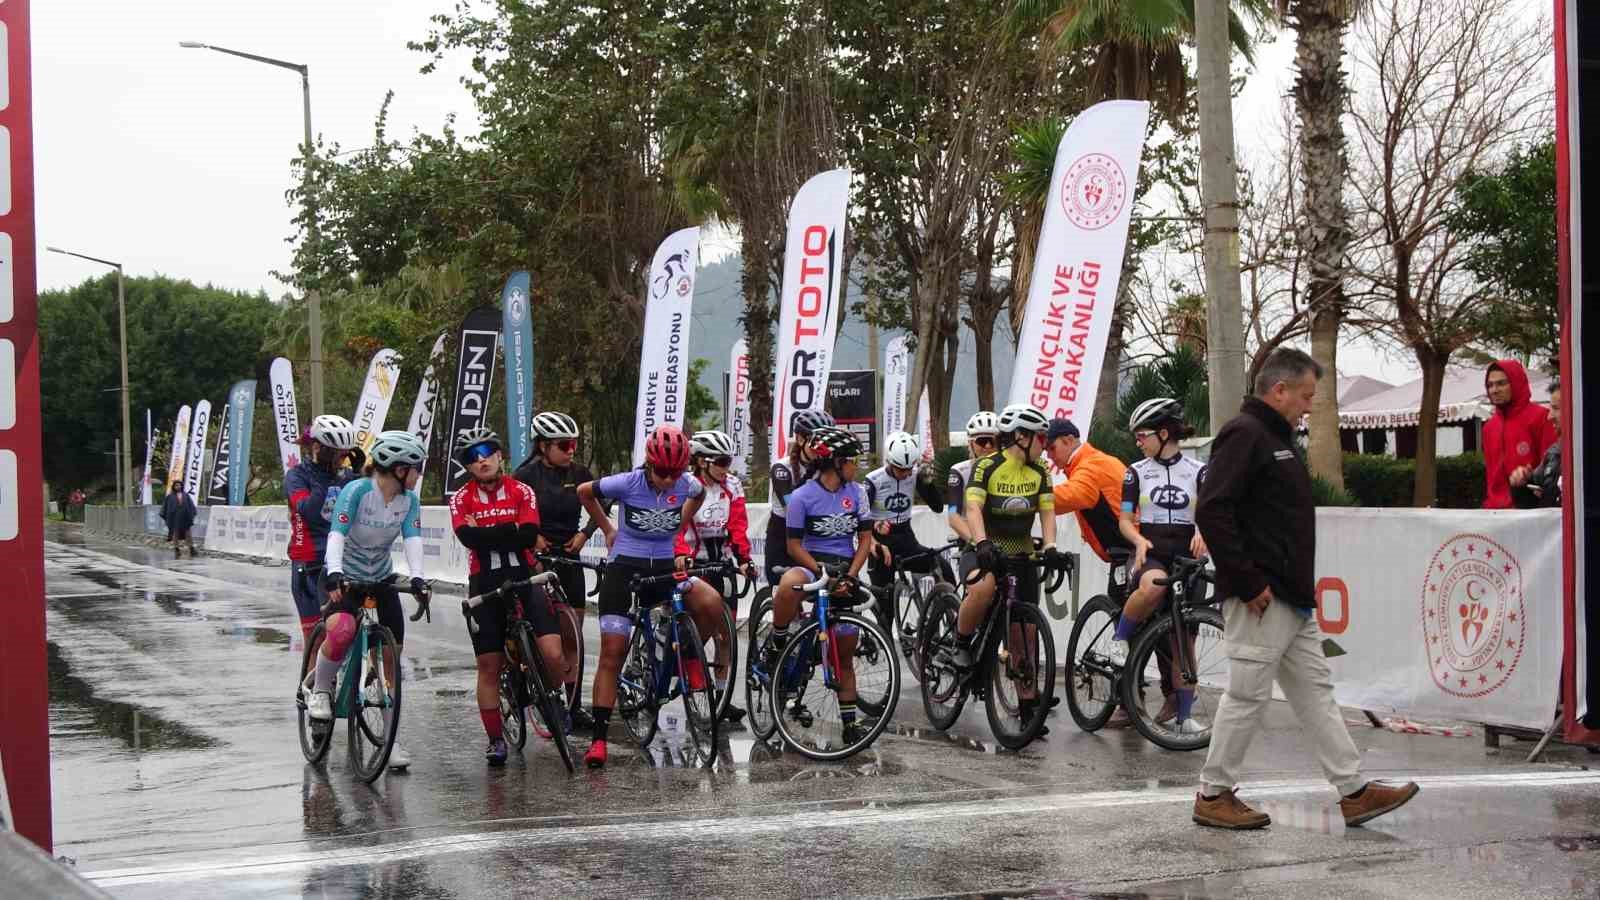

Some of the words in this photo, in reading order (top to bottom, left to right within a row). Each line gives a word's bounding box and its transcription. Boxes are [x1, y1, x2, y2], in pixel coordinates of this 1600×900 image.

[794, 225, 827, 345] TOTO
[1059, 261, 1101, 402] BAKANLIĞI
[664, 312, 683, 422] FEDERASYONU
[1031, 303, 1067, 410] GENÇLİK
[1052, 264, 1074, 297] VE
[275, 384, 290, 443] ANJELIQ
[450, 346, 487, 479] VDEN
[788, 350, 817, 438] OR
[830, 388, 861, 397] IŞLARI
[188, 412, 207, 495] MERCADO
[213, 415, 229, 489] VALDE
